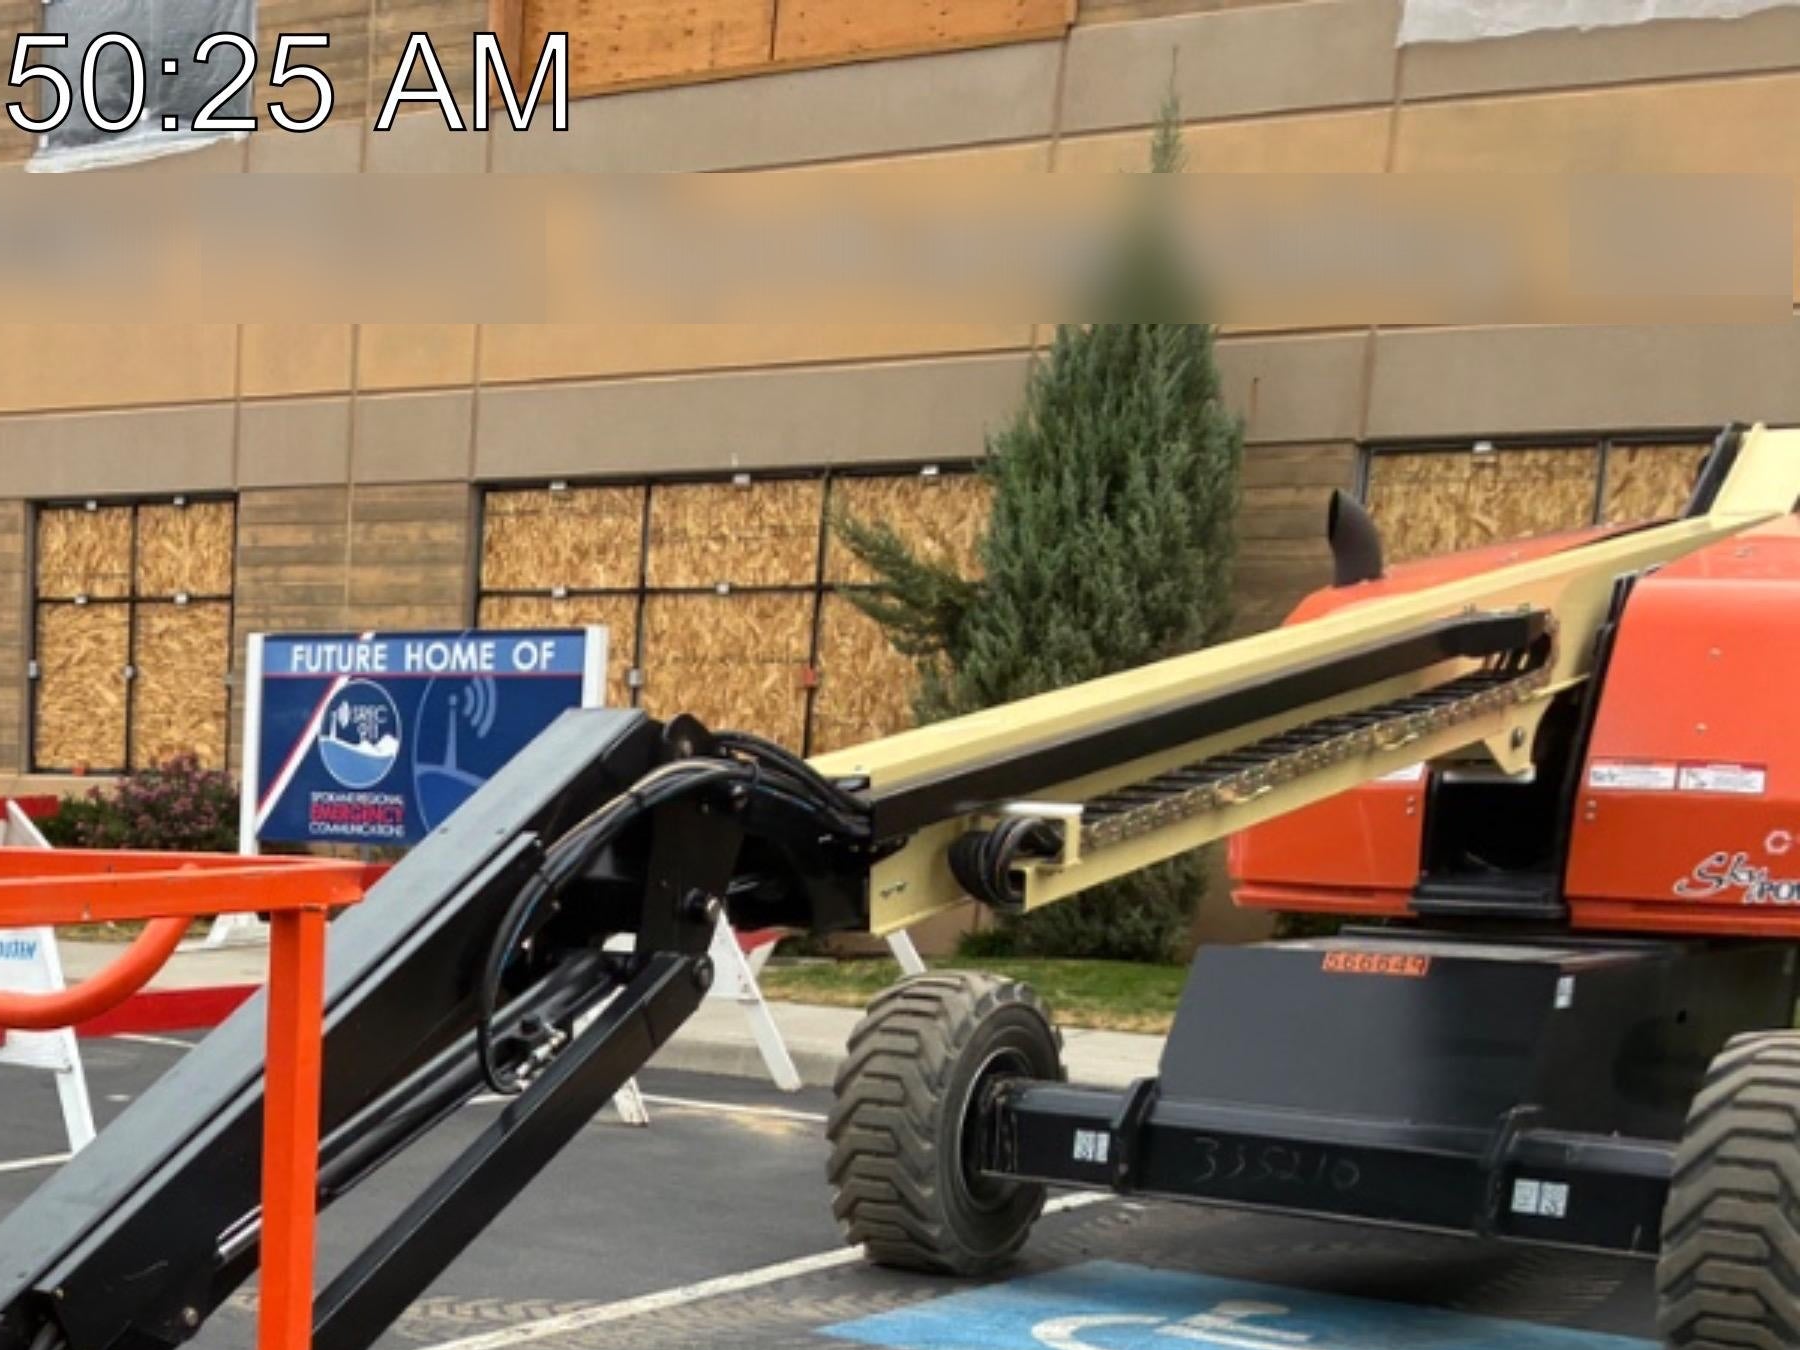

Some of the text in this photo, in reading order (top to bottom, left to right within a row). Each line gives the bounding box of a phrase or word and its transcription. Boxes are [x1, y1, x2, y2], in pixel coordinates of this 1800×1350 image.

[291, 640, 556, 672] FUTURE HOME OF
[310, 801, 404, 824] EMERGENCY
